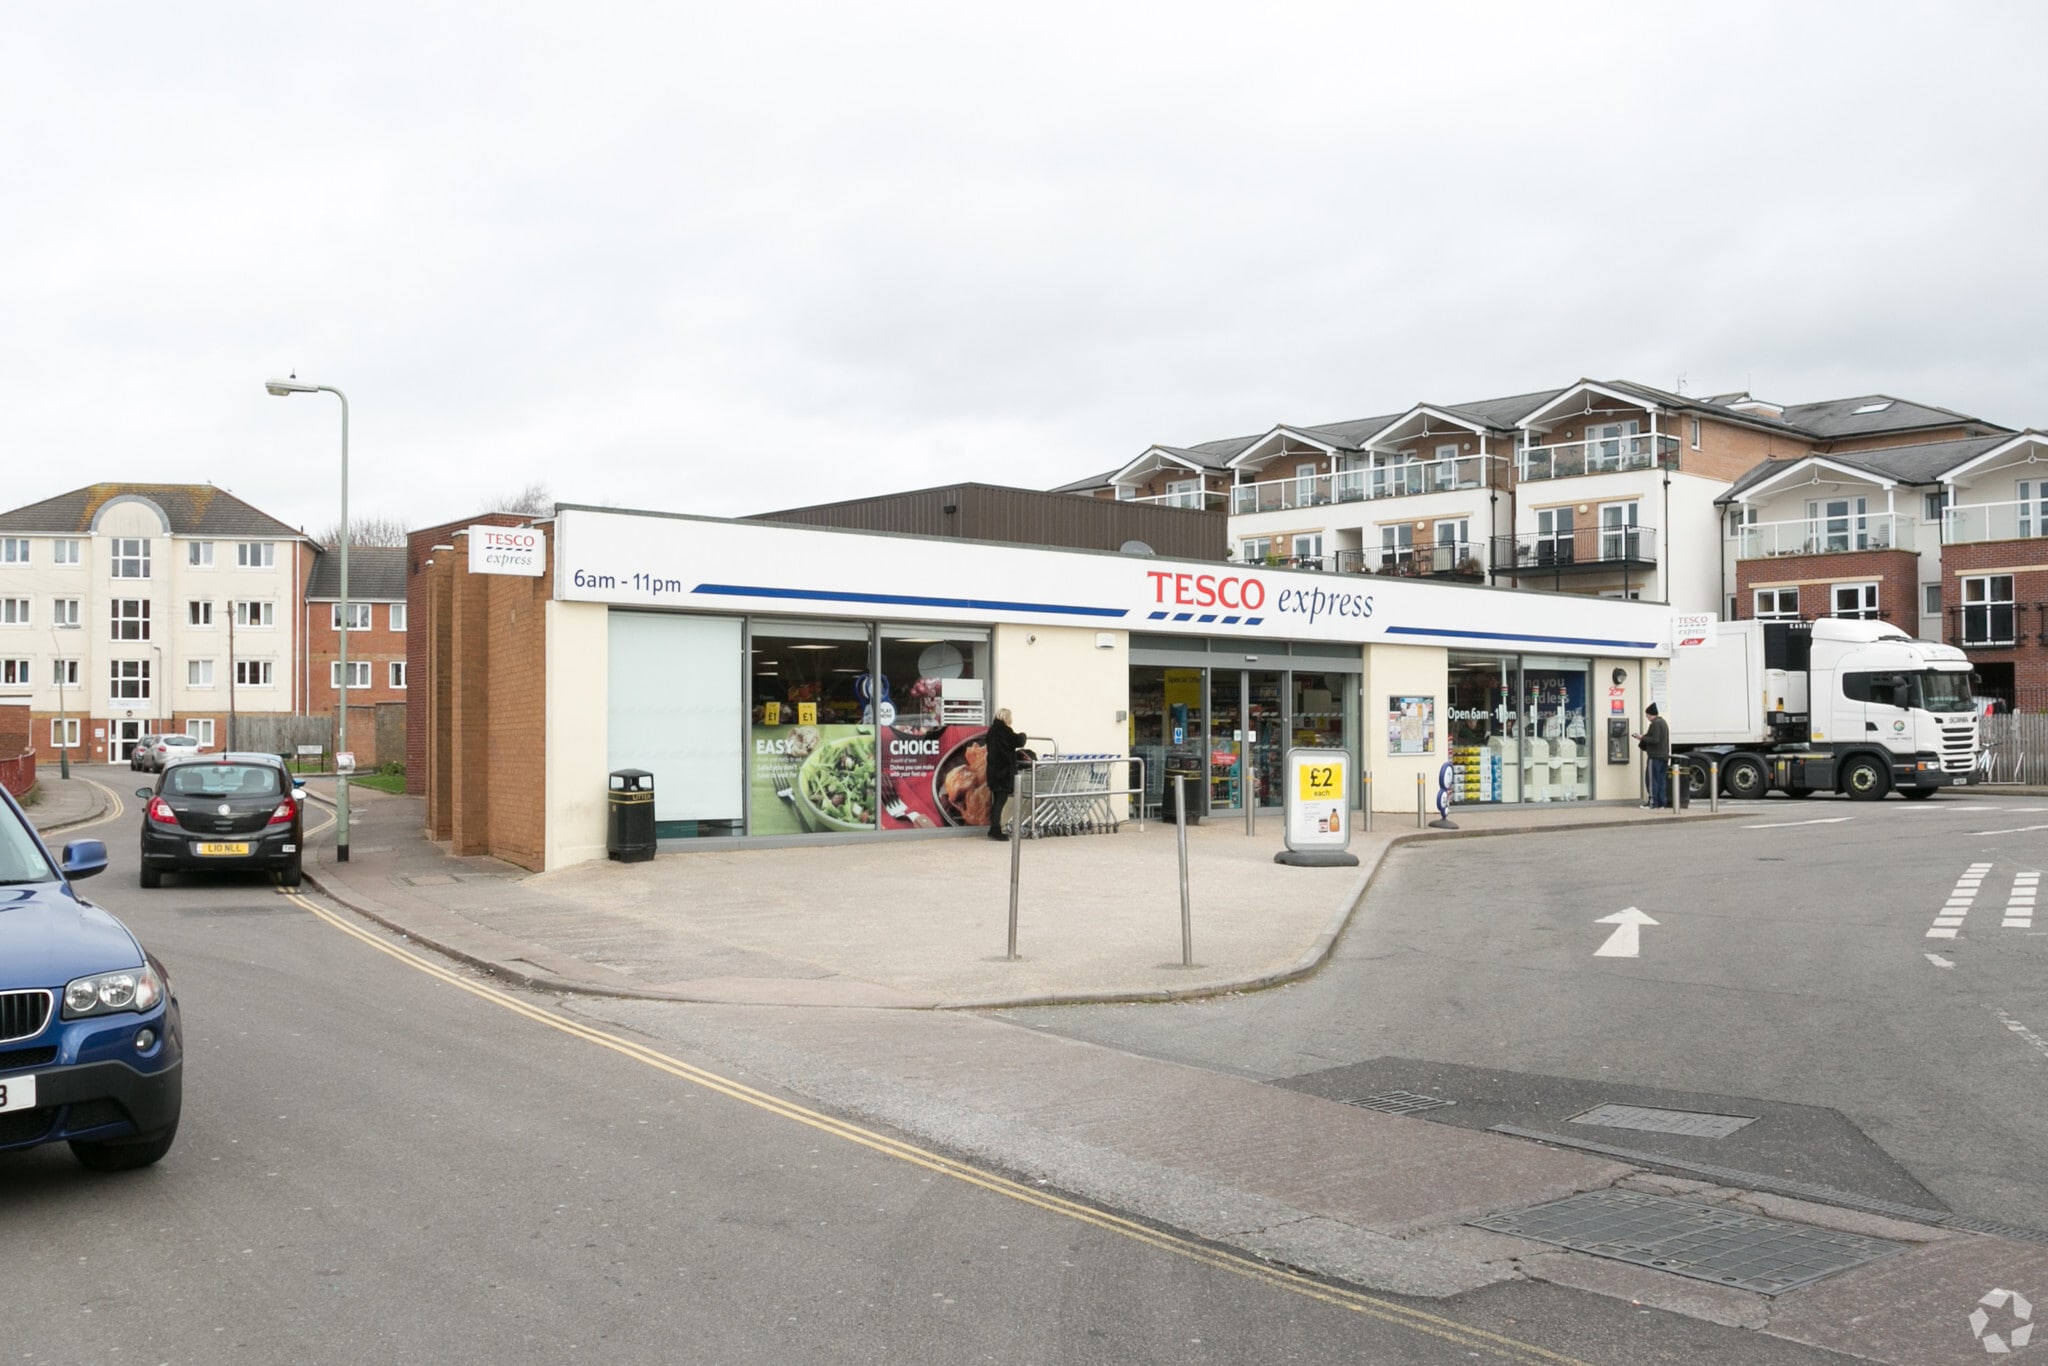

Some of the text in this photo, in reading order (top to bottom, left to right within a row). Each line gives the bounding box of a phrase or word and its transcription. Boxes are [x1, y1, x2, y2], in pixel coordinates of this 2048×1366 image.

[485, 532, 535, 547] TESCO
[486, 551, 532, 567] express
[574, 569, 616, 589] 6am
[633, 573, 681, 595] 11pm
[1147, 570, 1374, 625] TESCO express
[1678, 615, 1708, 624] TESCO
[1543, 678, 1565, 690] you
[768, 712, 777, 721] £1
[802, 712, 813, 721] £1
[1447, 706, 1469, 721] Open
[1471, 707, 1489, 720] 6am
[756, 739, 794, 754] EASY
[889, 739, 940, 755] CHOICE
[1310, 768, 1333, 787] £2
